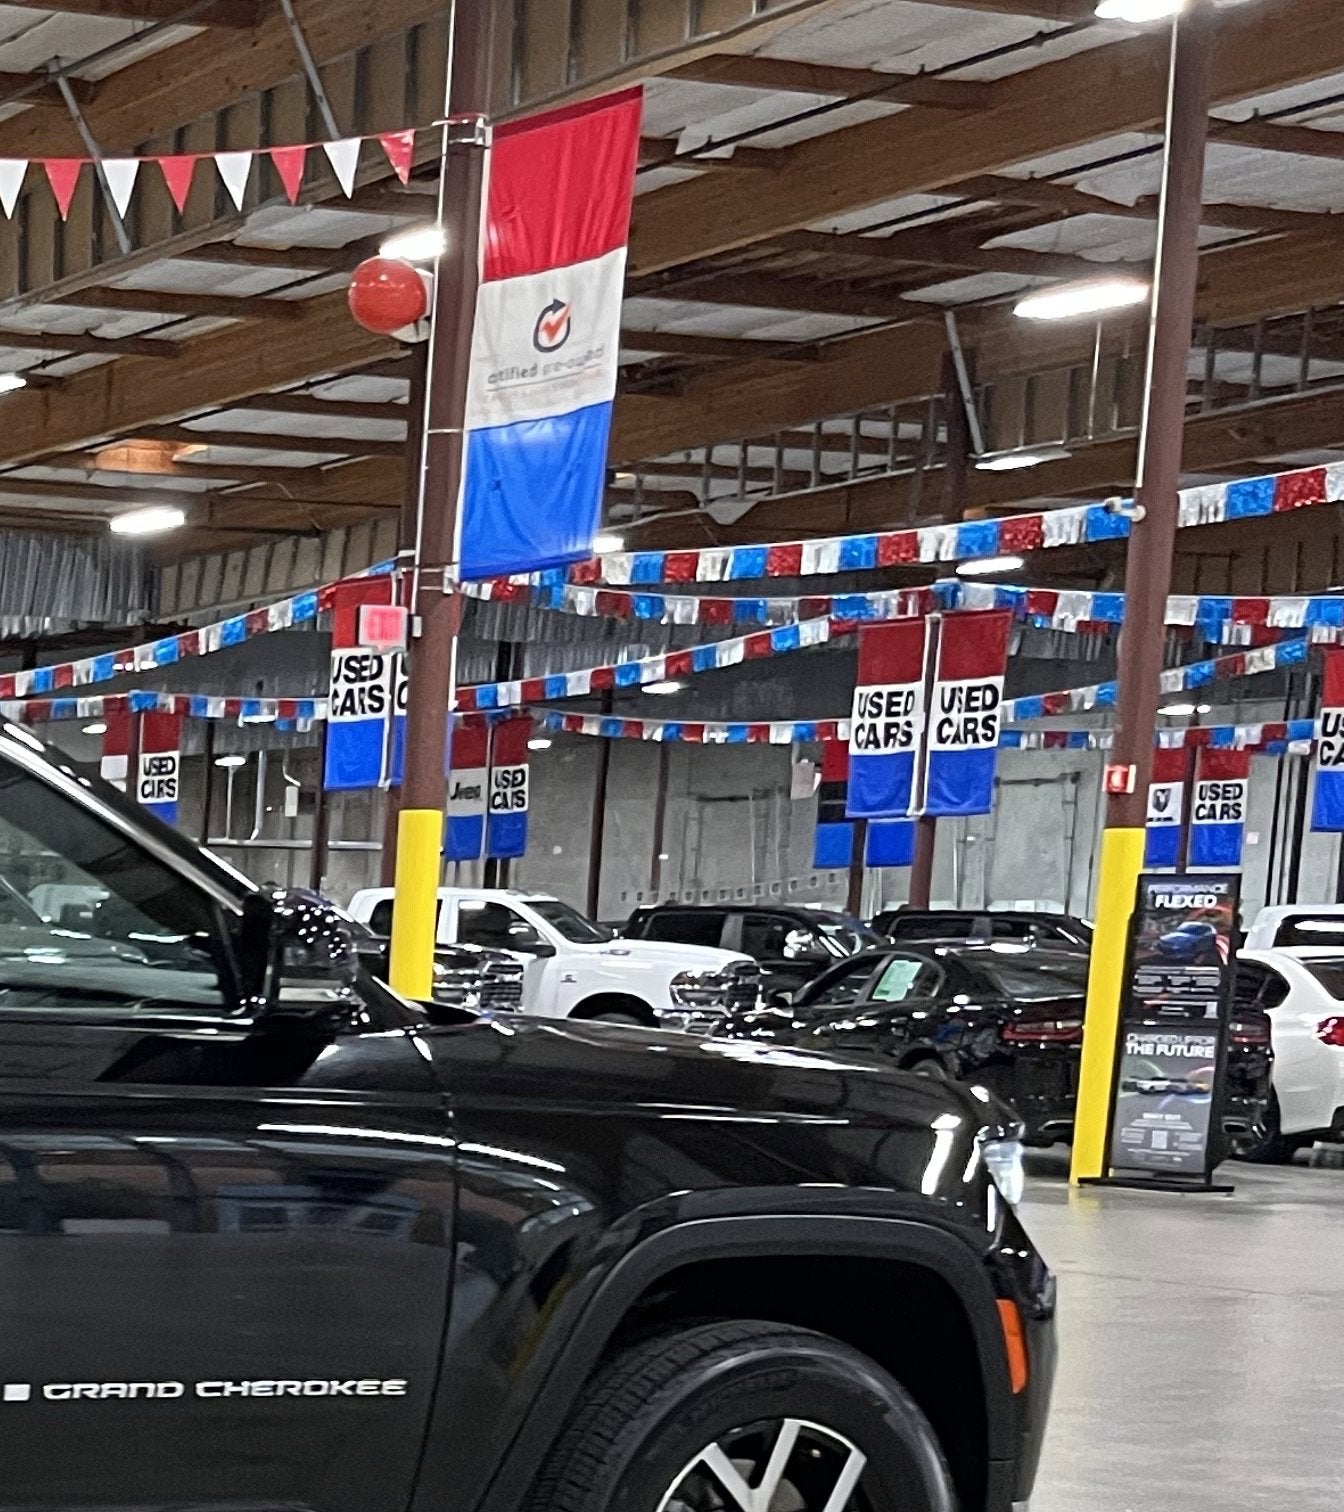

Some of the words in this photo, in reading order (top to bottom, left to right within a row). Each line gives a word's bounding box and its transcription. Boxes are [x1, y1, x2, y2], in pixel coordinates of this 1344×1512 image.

[332, 655, 384, 684] USED
[858, 690, 916, 718] USED
[941, 683, 1000, 714] USED
[854, 720, 913, 749] CARS
[936, 714, 998, 744] CARS
[143, 756, 176, 776] USED
[1198, 783, 1244, 801] USED
[1195, 803, 1242, 820] CARS
[1155, 894, 1218, 909] FLEXED
[1125, 1042, 1154, 1055] THE
[1156, 1044, 1216, 1059] FUTURE
[42, 1382, 185, 1400] GRAND
[195, 1378, 409, 1399] CHEROKEE
